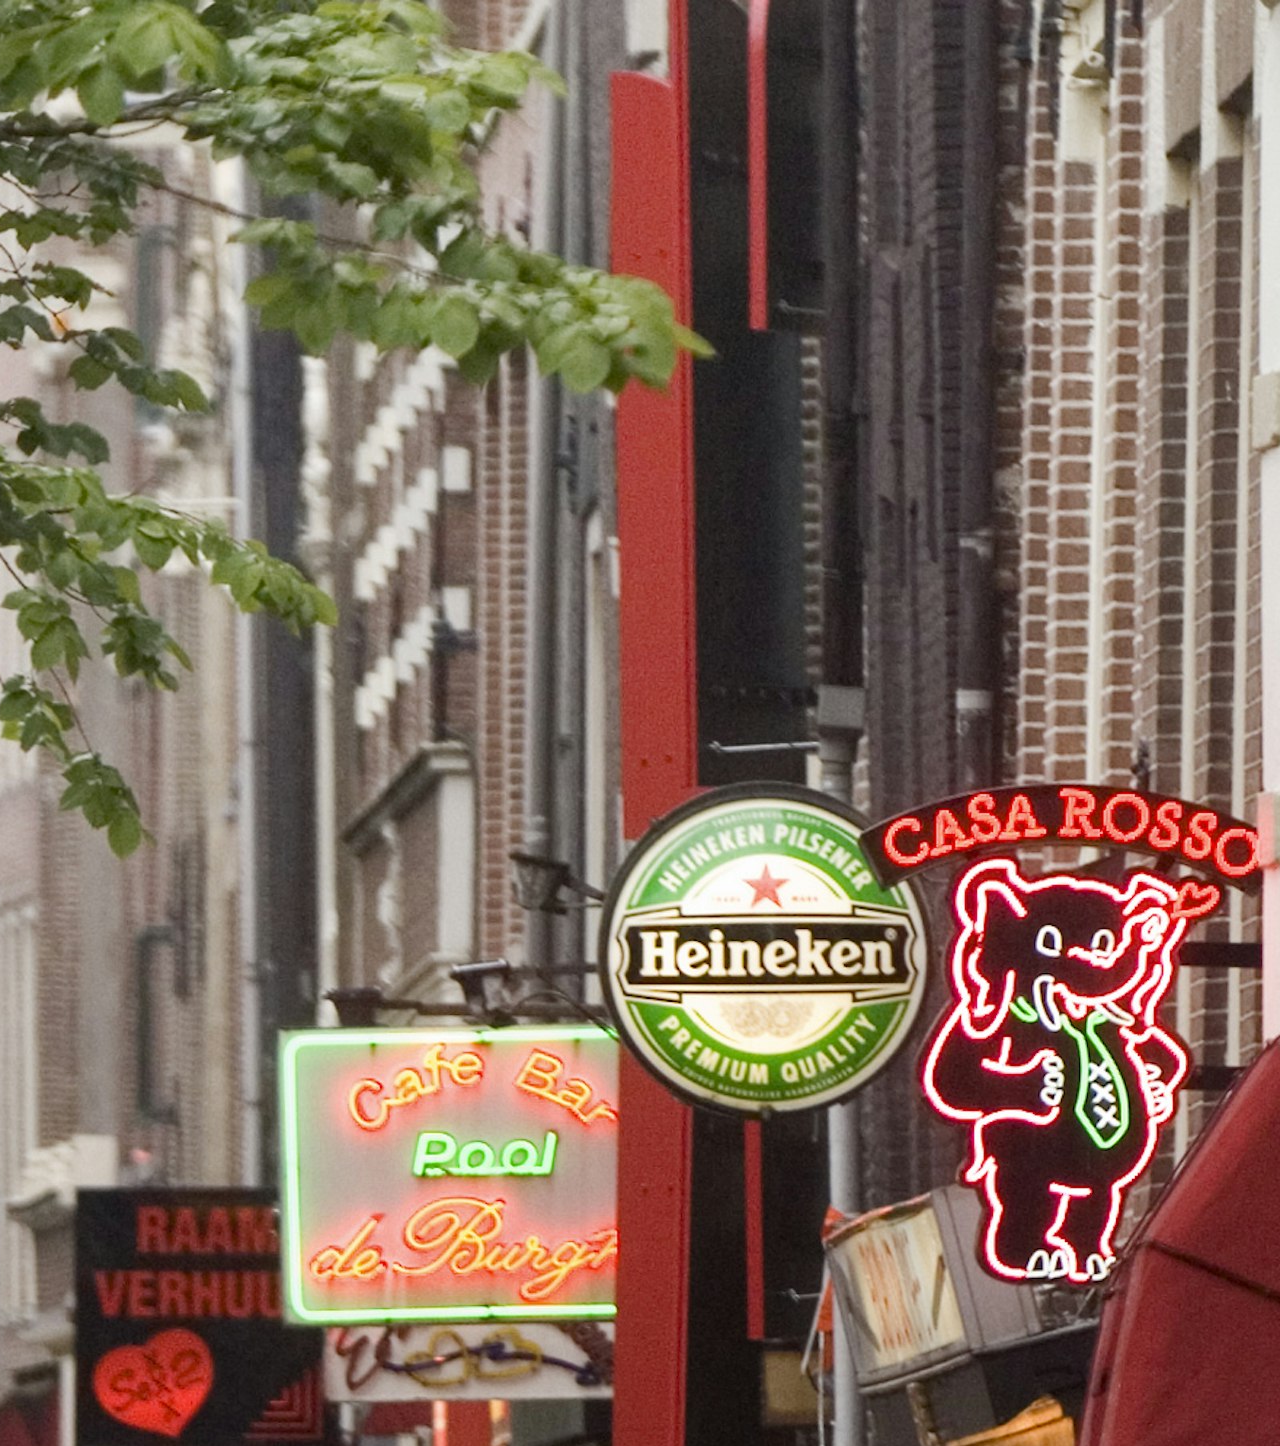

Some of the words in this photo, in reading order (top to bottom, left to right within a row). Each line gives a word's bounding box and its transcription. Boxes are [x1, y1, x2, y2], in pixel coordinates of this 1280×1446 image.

[658, 824, 765, 892] HEINEKEN
[774, 824, 873, 891] PILSENER
[884, 794, 1047, 864] CASA
[1059, 787, 1260, 876] ROSSO
[640, 929, 895, 977] Heineken
[657, 1014, 768, 1084] PREMIUM
[781, 1012, 877, 1082] QUALITY
[348, 1042, 483, 1130] Cafe
[515, 1049, 617, 1125] Bar
[413, 1130, 557, 1176] Pool
[311, 1214, 387, 1278] de
[95, 1271, 283, 1318] VERHUU
